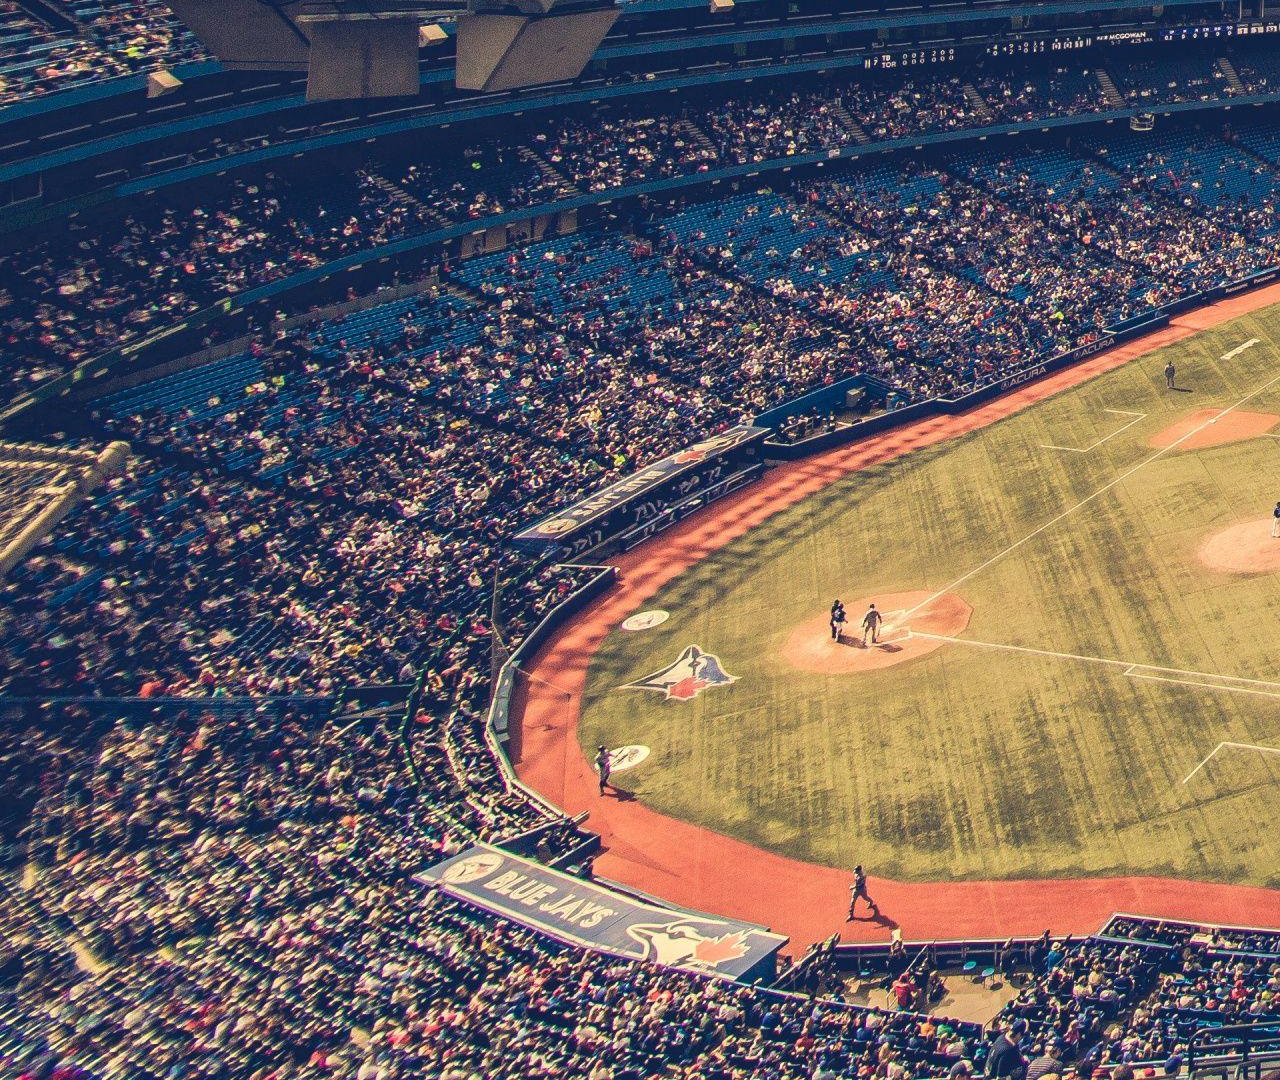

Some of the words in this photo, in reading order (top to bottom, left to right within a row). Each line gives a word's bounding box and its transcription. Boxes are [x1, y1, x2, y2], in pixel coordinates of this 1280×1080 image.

[1109, 32, 1146, 40] MCGOWAN
[1080, 338, 1114, 357] ACURA
[1009, 366, 1046, 387] ACURA
[572, 492, 620, 517] JAYS
[483, 871, 551, 907] BLUE
[542, 889, 613, 928] JAYS
